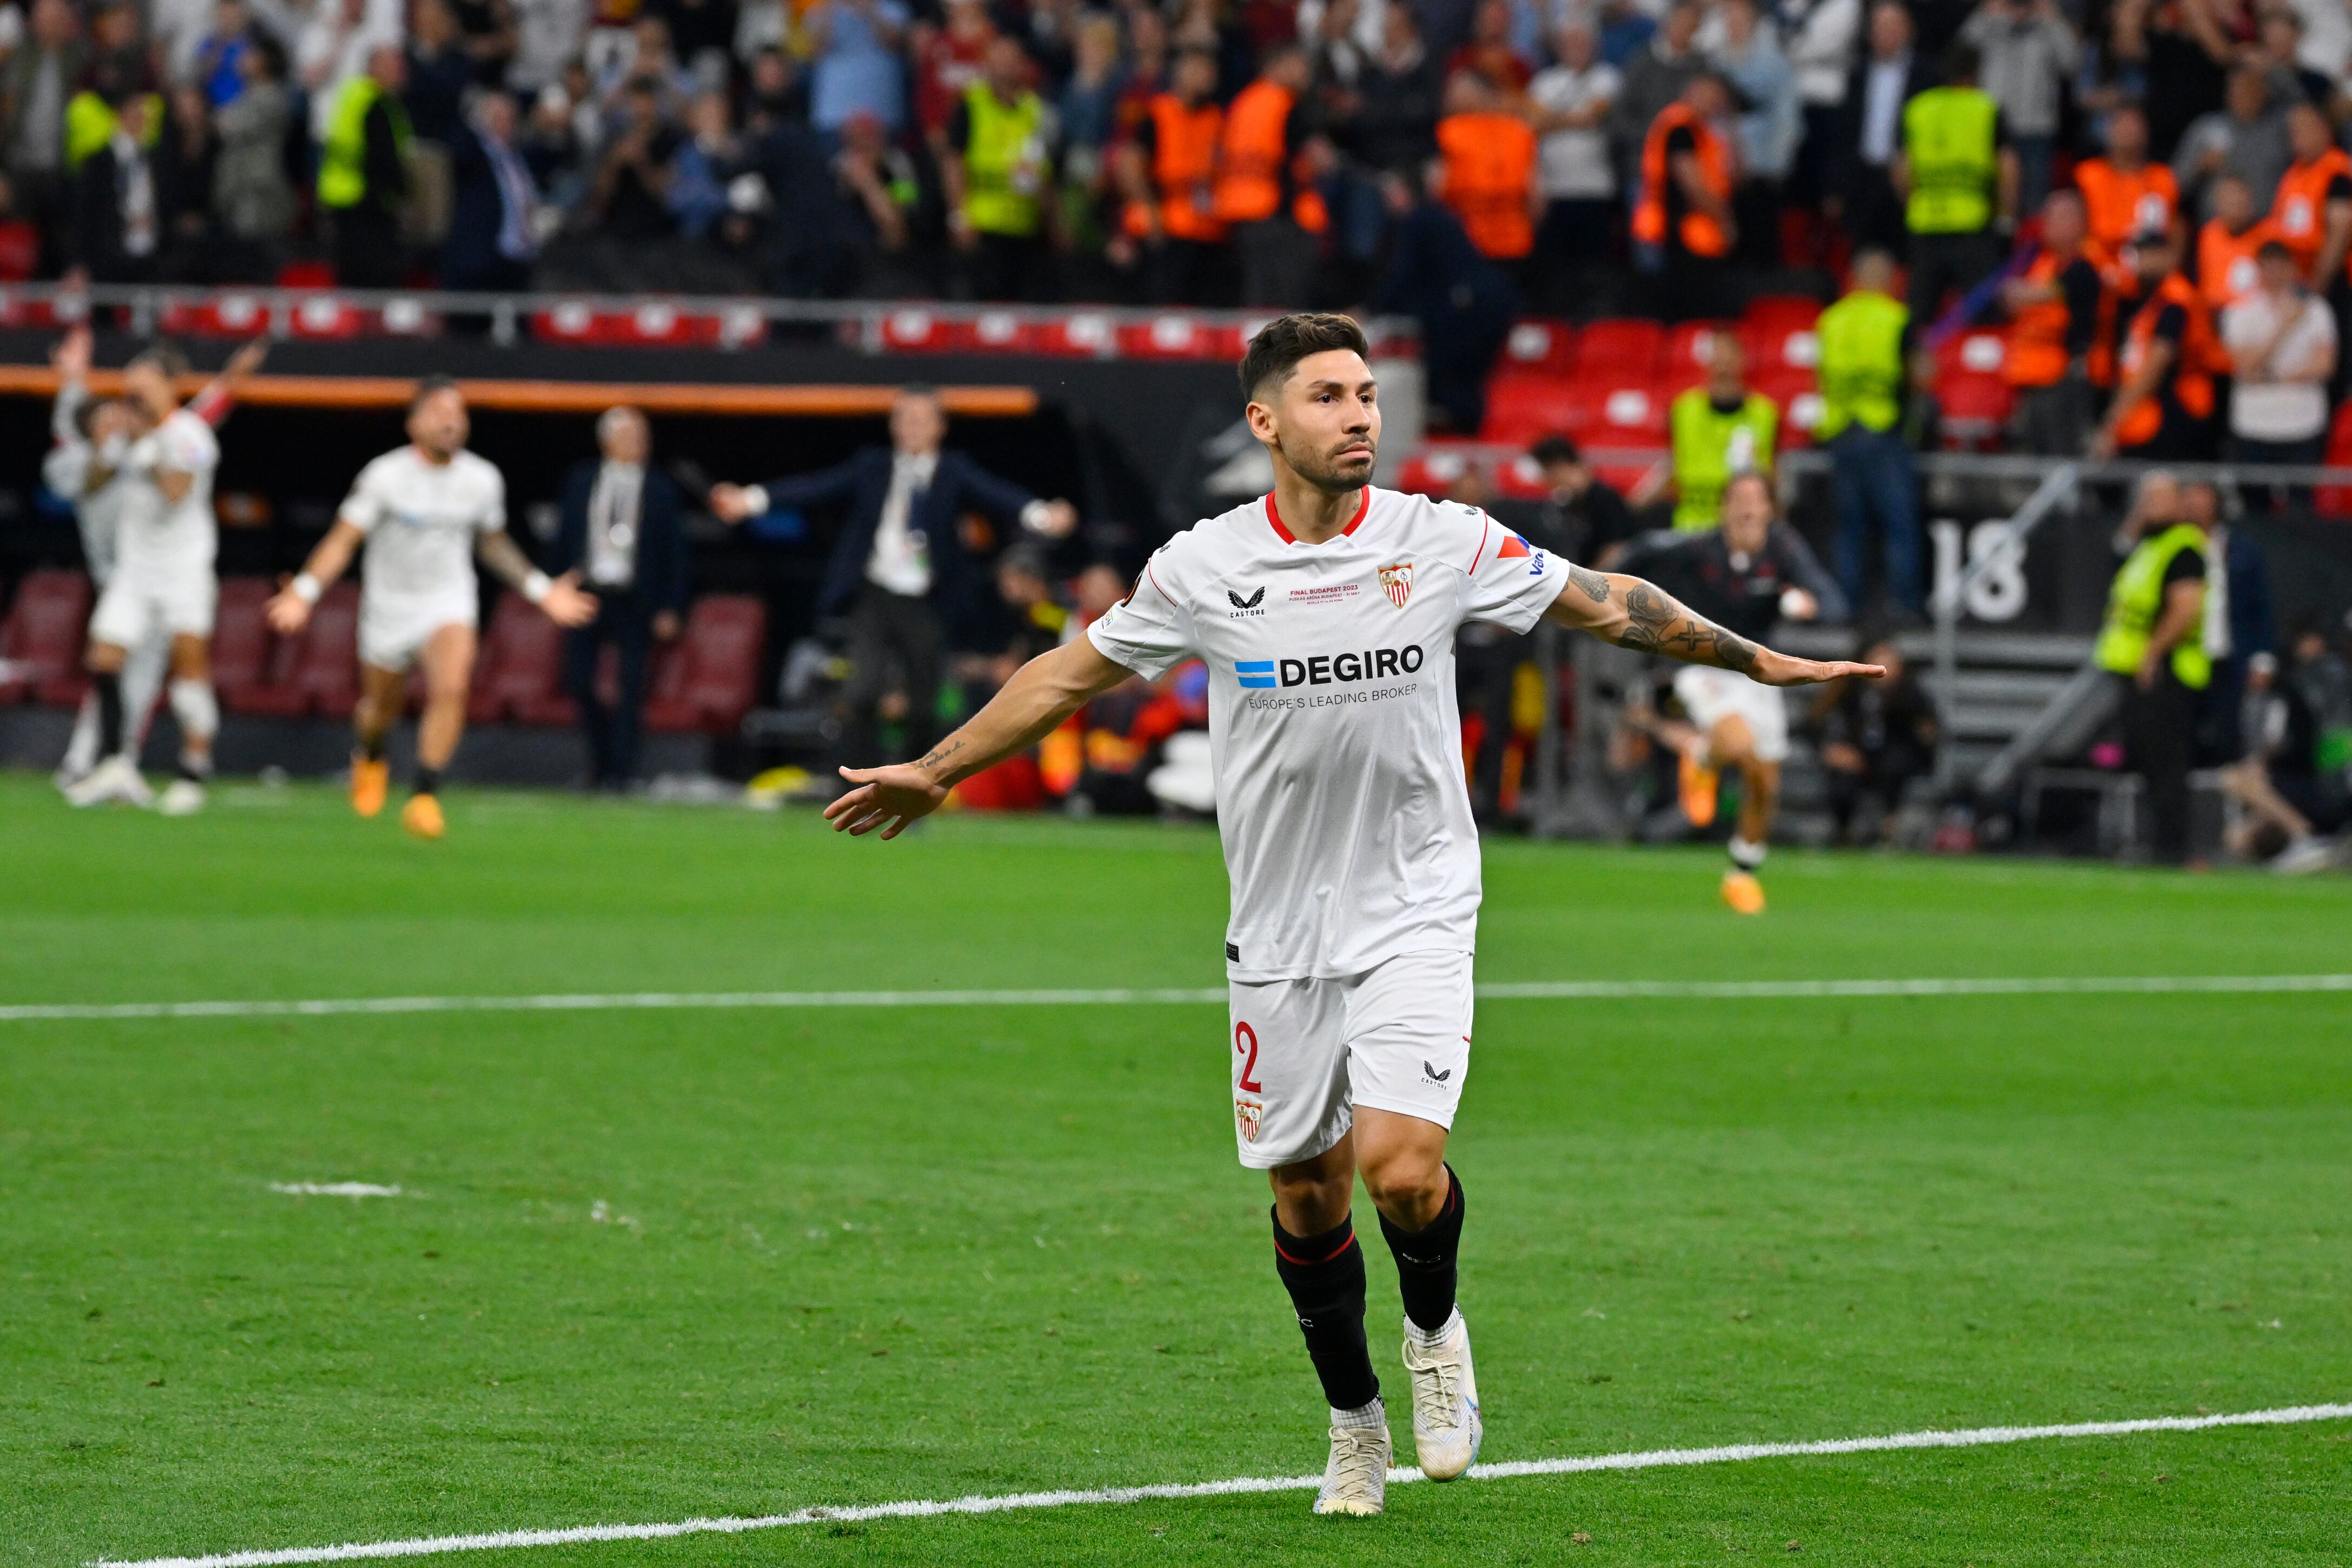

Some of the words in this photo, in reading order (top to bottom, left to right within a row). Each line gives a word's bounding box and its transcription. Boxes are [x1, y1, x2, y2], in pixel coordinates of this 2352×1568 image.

[1926, 518, 2029, 622] 18
[1230, 609, 1265, 618] CASTORE
[1280, 644, 1424, 688] DEGIRO
[1309, 692, 1367, 707] LEADING
[1372, 683, 1417, 701] BROKER
[1235, 1021, 1261, 1093] 2
